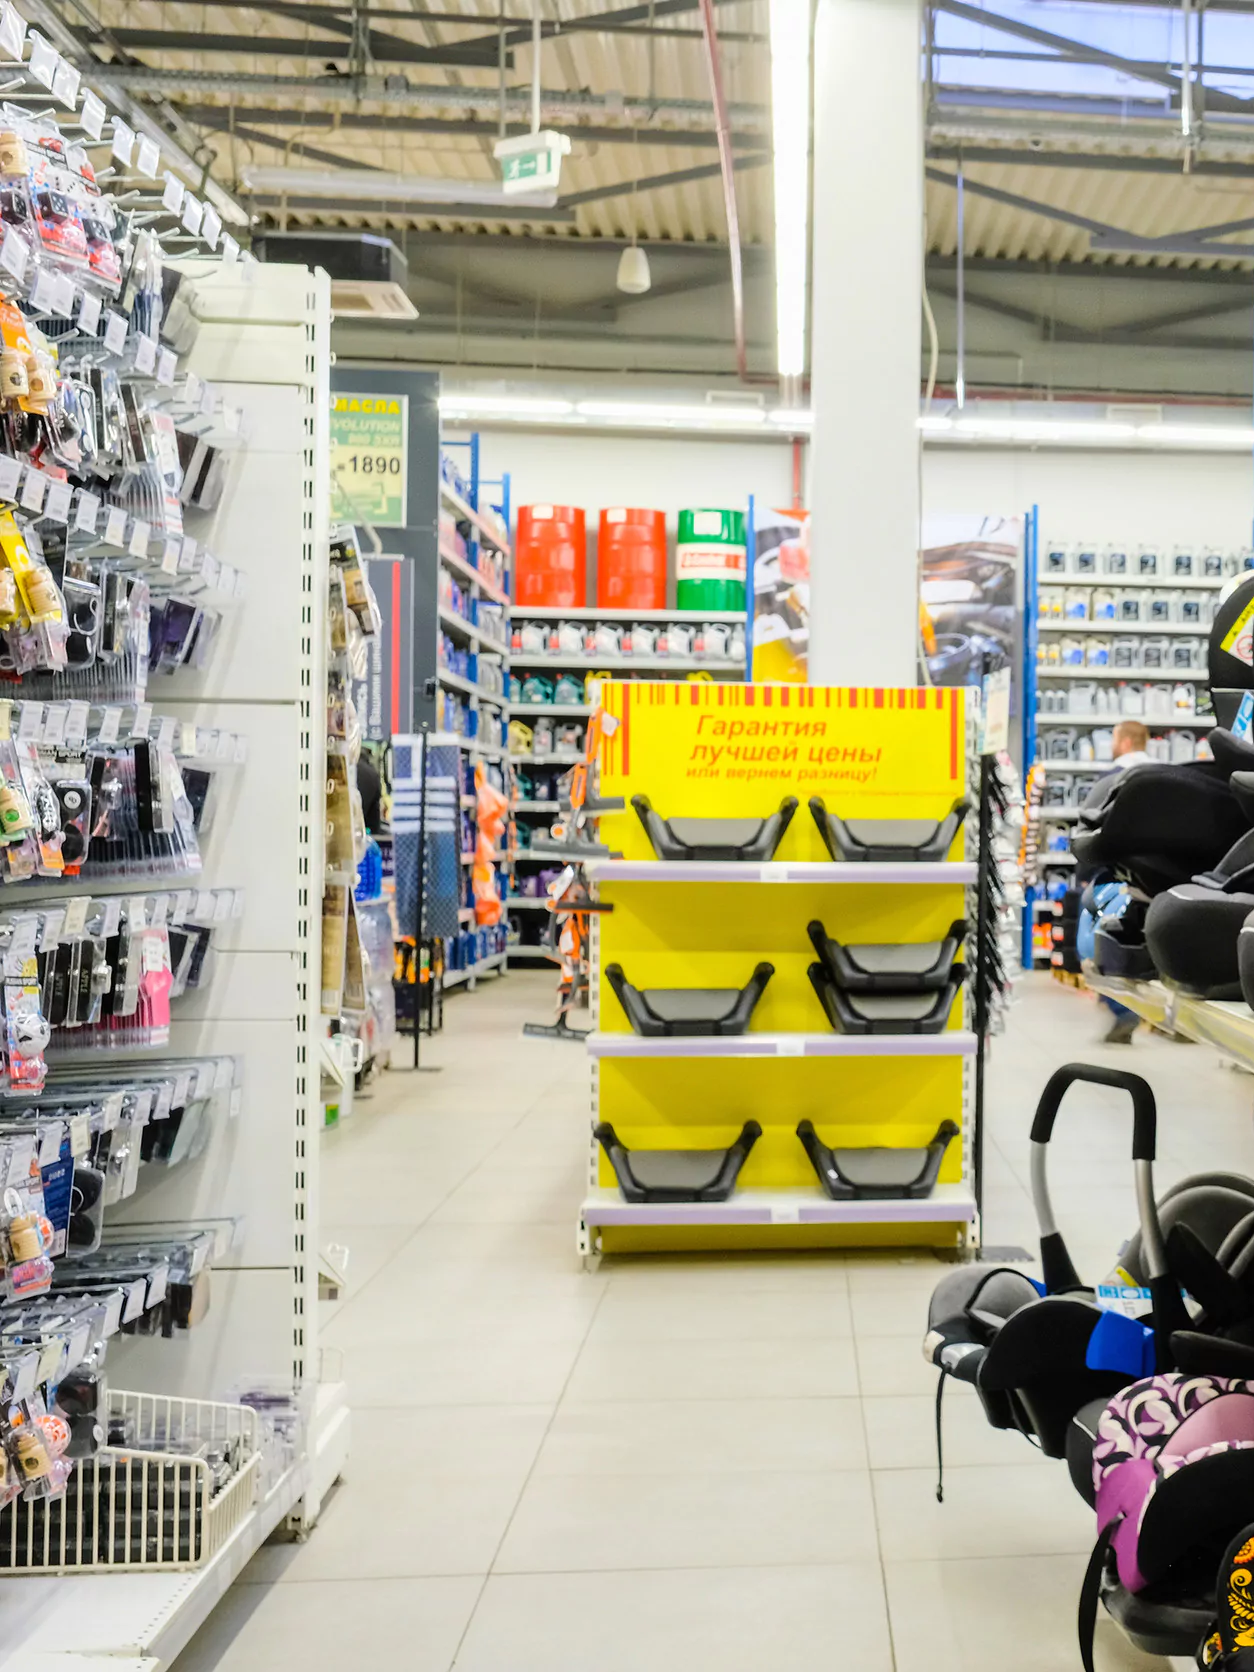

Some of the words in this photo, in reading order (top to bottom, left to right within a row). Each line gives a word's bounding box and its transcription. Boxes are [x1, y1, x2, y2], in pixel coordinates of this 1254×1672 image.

[349, 455, 400, 475] 1890
[697, 714, 827, 741] Гарантия
[690, 743, 798, 766] лучшей
[807, 746, 882, 764] цены
[686, 767, 720, 780] или
[725, 767, 792, 780] вернем
[797, 767, 878, 782] разницу!
